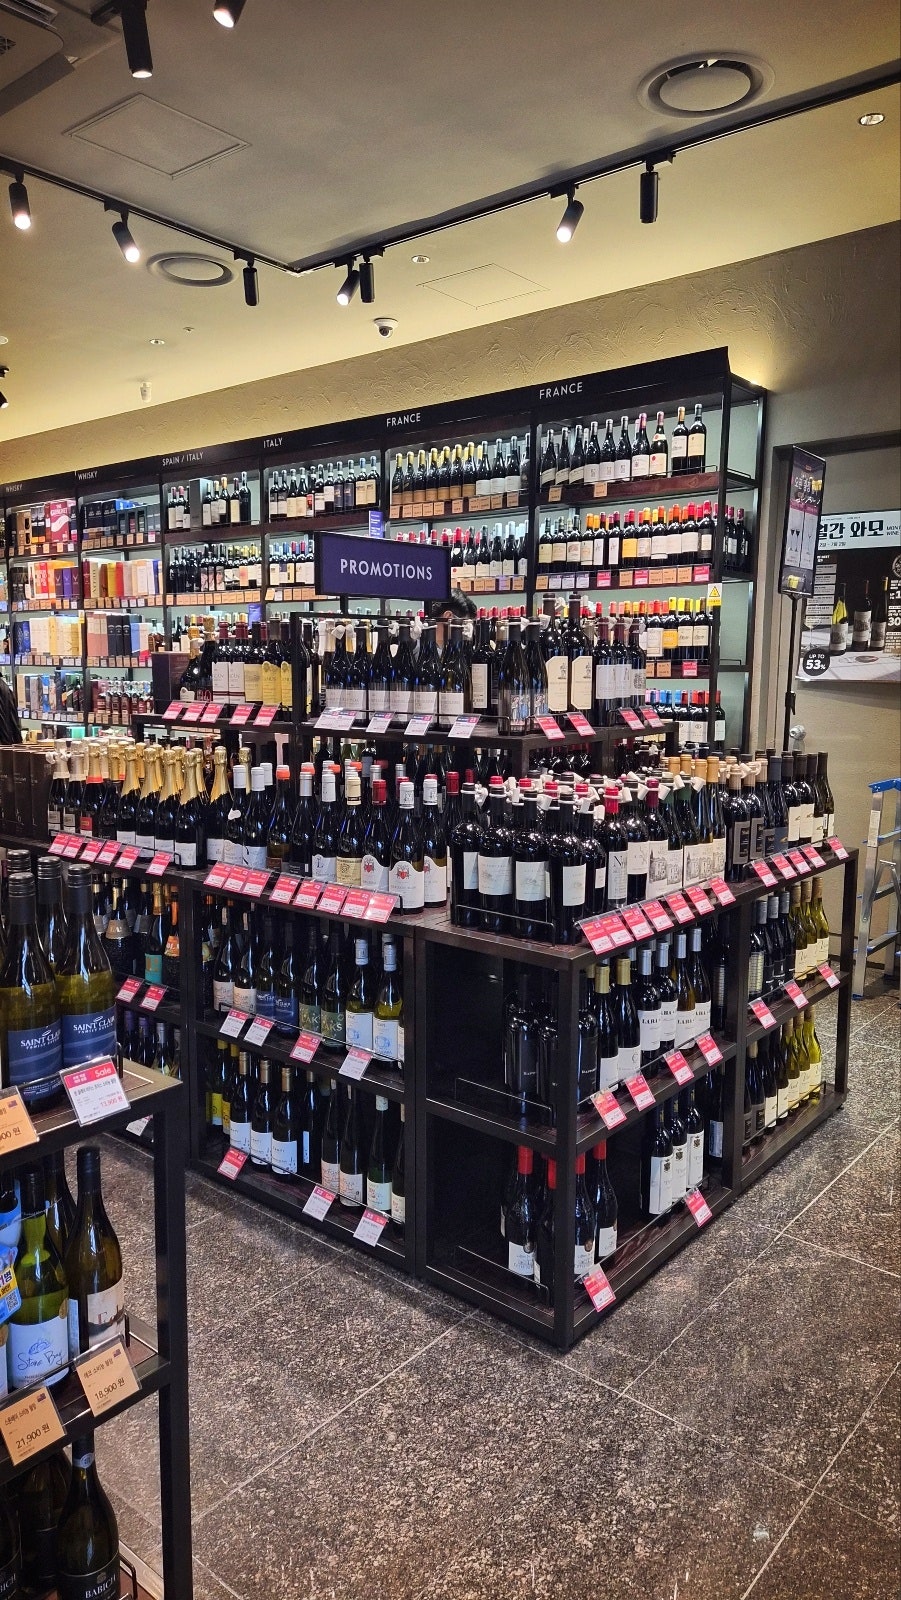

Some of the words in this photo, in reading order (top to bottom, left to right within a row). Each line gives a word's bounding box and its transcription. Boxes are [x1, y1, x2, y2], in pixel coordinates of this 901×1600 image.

[539, 381, 583, 399] FRANCE
[386, 412, 421, 427] FRANCE
[263, 437, 283, 448] ITALY
[162, 456, 180, 467] SPAIN
[186, 452, 204, 462] ITALY
[77, 470, 98, 481] WHISKY
[5, 484, 23, 493] WHISKY
[340, 558, 433, 581] PROMOTIONS
[806, 659, 826, 670] 53%
[73, 1021, 96, 1031] SAINT
[21, 1036, 46, 1047] SAINT
[94, 1067, 111, 1078] Sale
[17, 1352, 42, 1371] Stone
[43, 1350, 66, 1366] Bay
[94, 1381, 118, 1400] 18,900
[117, 1379, 125, 1388] 원
[15, 1429, 42, 1449] 21,900
[41, 1422, 51, 1434] 원
[85, 1573, 116, 1599] BABICH
